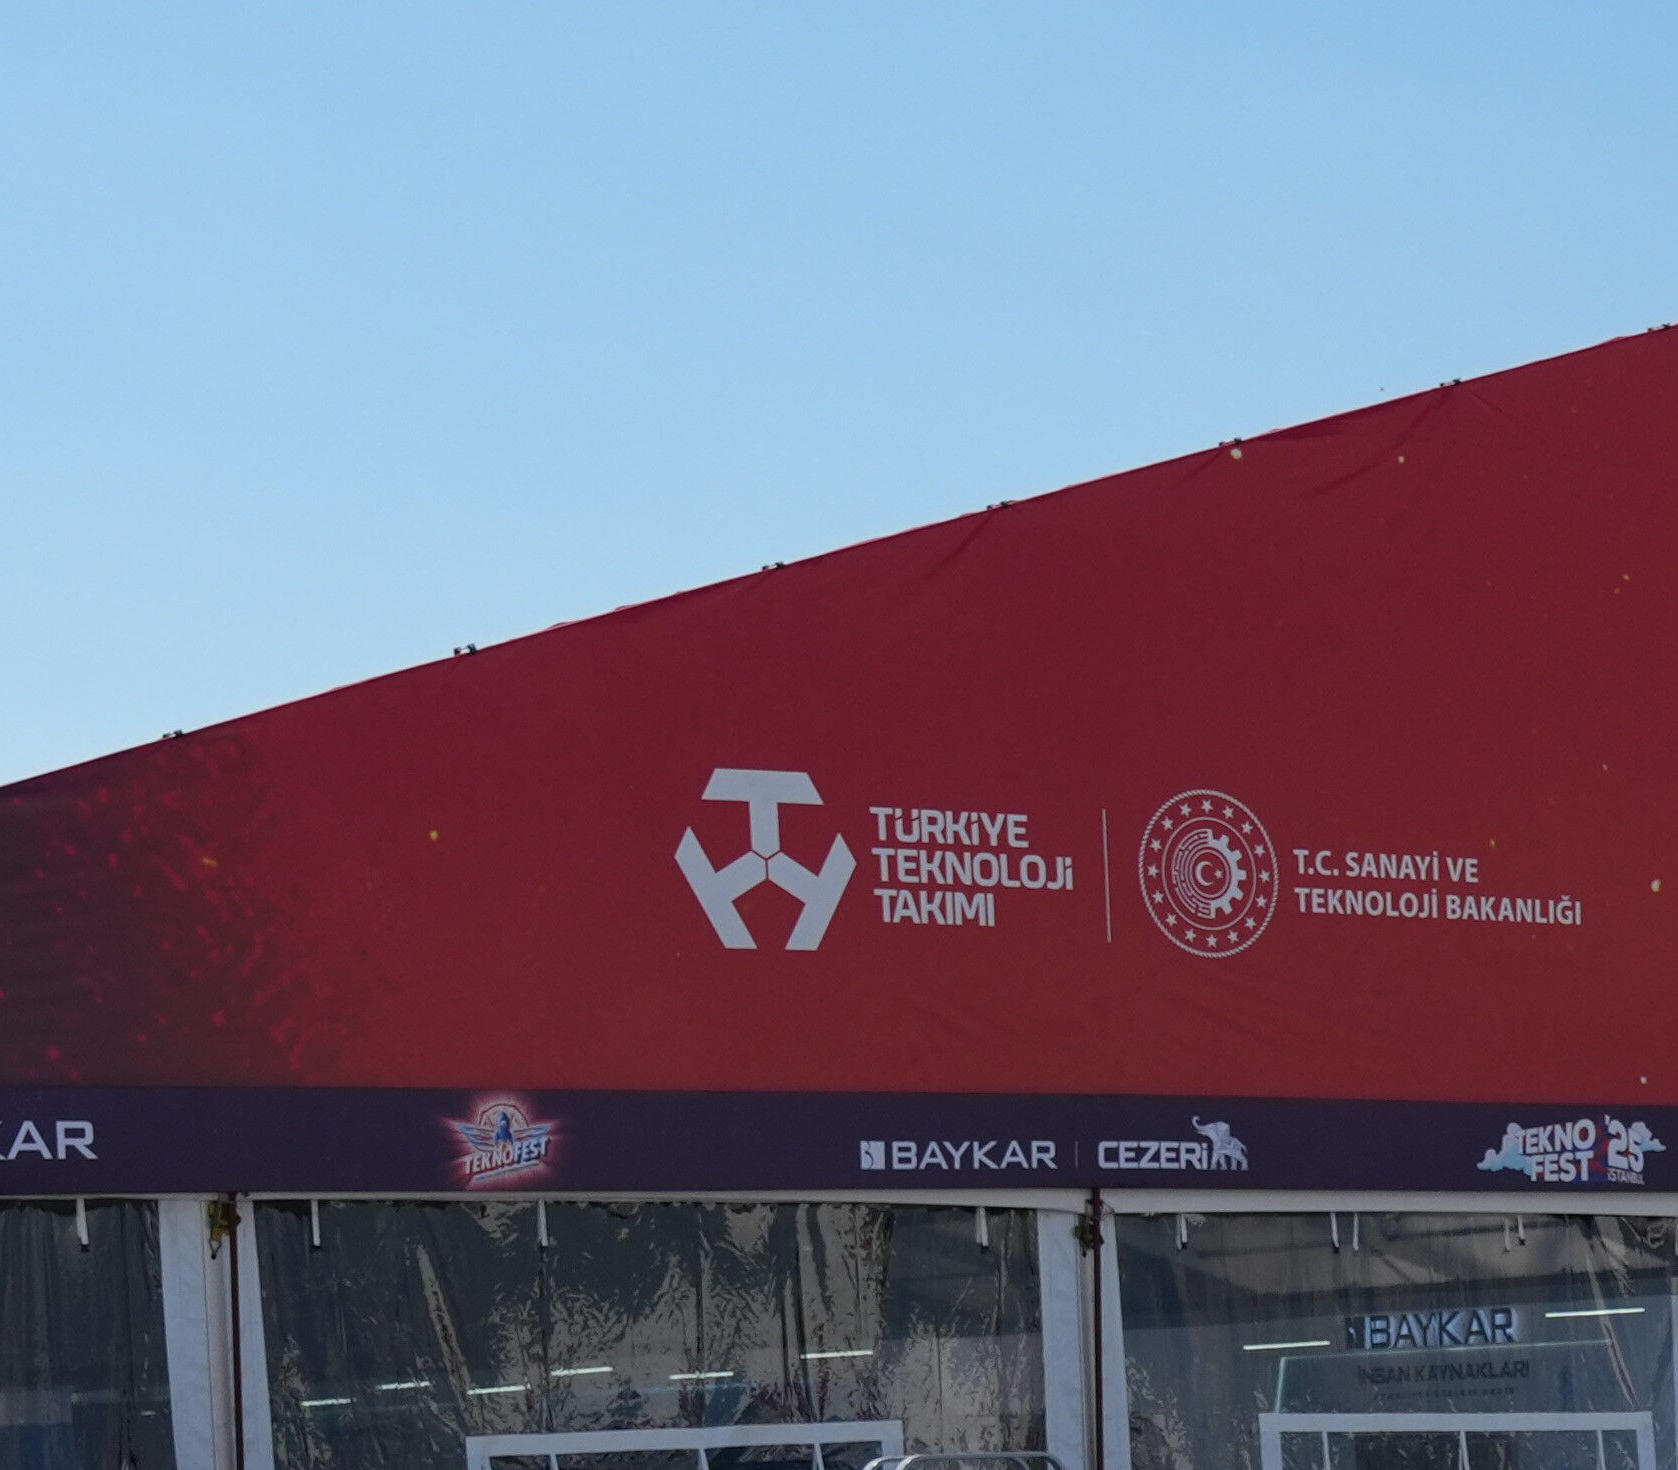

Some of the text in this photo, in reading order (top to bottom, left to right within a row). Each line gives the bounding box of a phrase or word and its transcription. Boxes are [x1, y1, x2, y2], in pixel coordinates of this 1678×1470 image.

[1292, 849, 1478, 884] T.C. SANAYİ VE
[874, 889, 996, 927] TAKIMI
[1294, 884, 1582, 926] TEKNOLOJİ BAKANLIĞI
[463, 1136, 550, 1175] TEKNOFEST
[891, 1140, 1057, 1171] BAYKAR
[1519, 1119, 1596, 1155] TEKNO
[1530, 1150, 1595, 1183] FEST
[1370, 1306, 1518, 1349] BAYKAR
